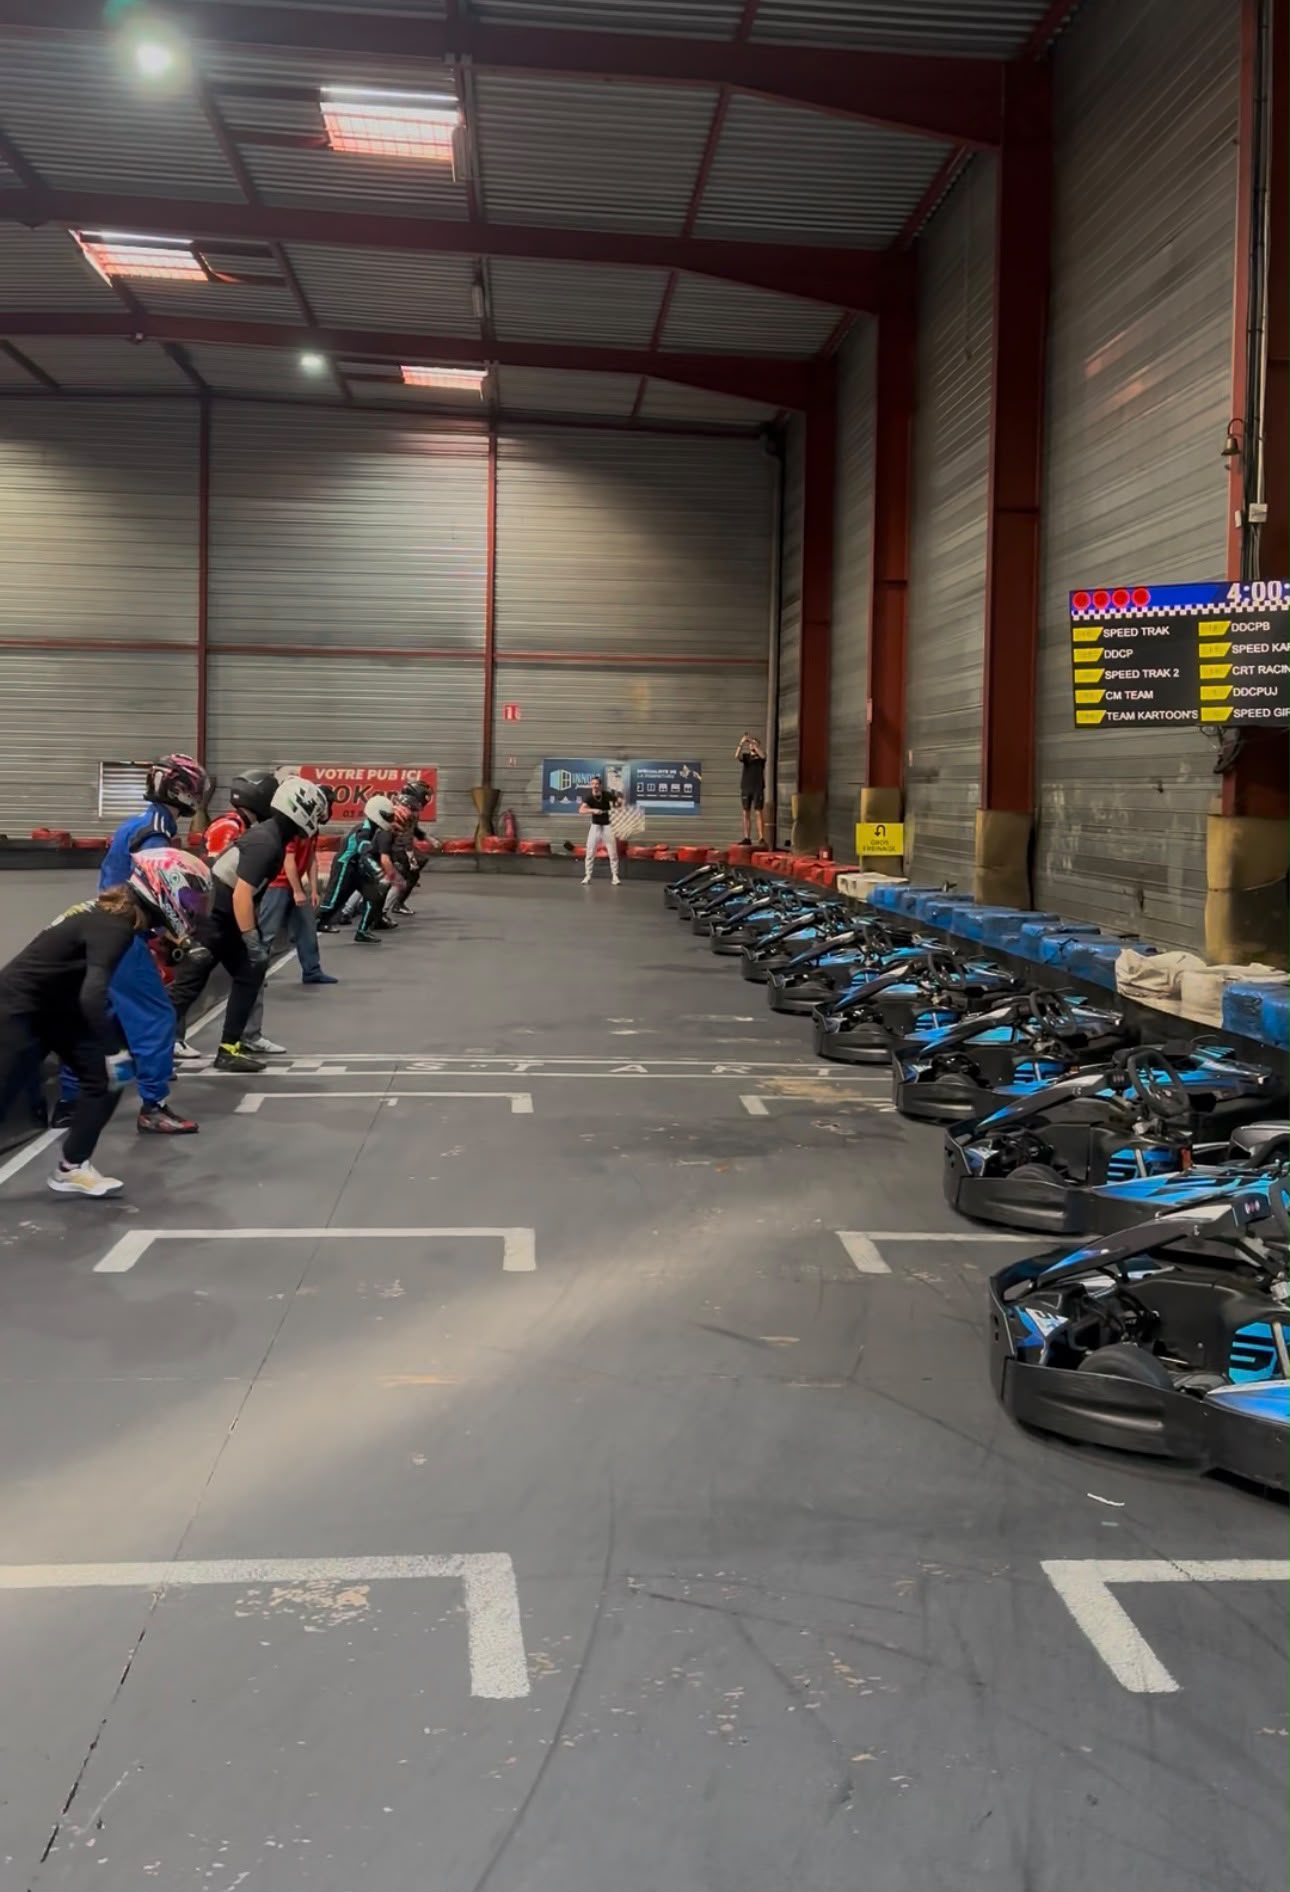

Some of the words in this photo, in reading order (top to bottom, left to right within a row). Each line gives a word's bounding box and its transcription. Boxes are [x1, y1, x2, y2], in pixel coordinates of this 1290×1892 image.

[1103, 627, 1138, 638] SPEED
[1141, 626, 1170, 637] TRAK
[1231, 622, 1271, 633] DDCPB
[1232, 643, 1269, 654] SPEED
[1104, 649, 1134, 660] DDCP
[1104, 669, 1141, 680] SPEED
[1143, 668, 1172, 678] TRAK
[1173, 668, 1180, 678] 2
[1232, 665, 1256, 676] CRT
[1105, 690, 1122, 701] CM
[1124, 690, 1154, 700] TEAM
[1233, 686, 1278, 697] DDCPUJ
[1106, 711, 1136, 721] TEAM
[1137, 709, 1199, 720] KARTOON'S
[1233, 708, 1272, 719] SPEED
[315, 768, 363, 780] VOTRE
[367, 769, 398, 781] PUB
[400, 769, 422, 781] ICI
